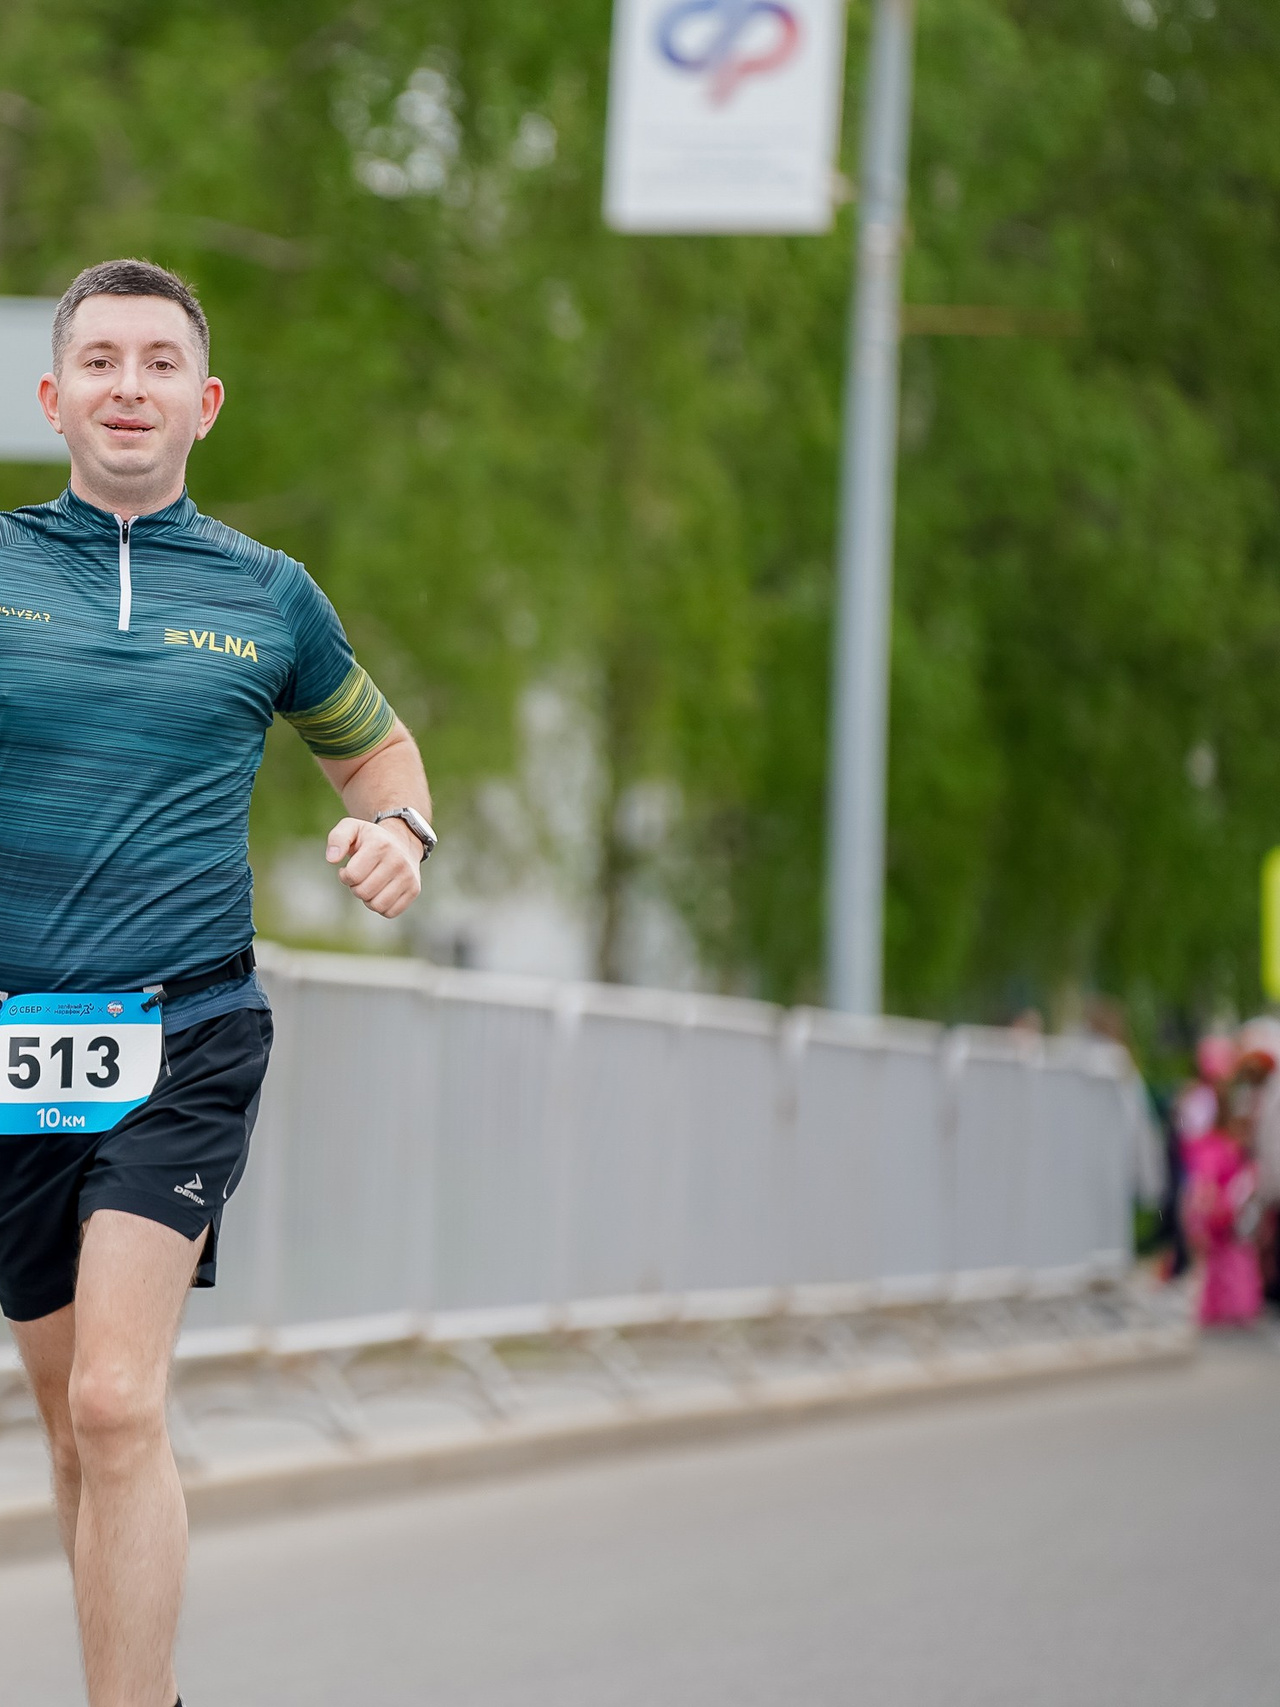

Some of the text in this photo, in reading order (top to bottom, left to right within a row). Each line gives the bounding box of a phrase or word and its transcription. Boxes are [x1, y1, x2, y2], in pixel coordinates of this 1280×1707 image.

[189, 629, 258, 663] VLNA
[19, 1005, 42, 1014] СБЕР
[7, 1036, 120, 1089] 513
